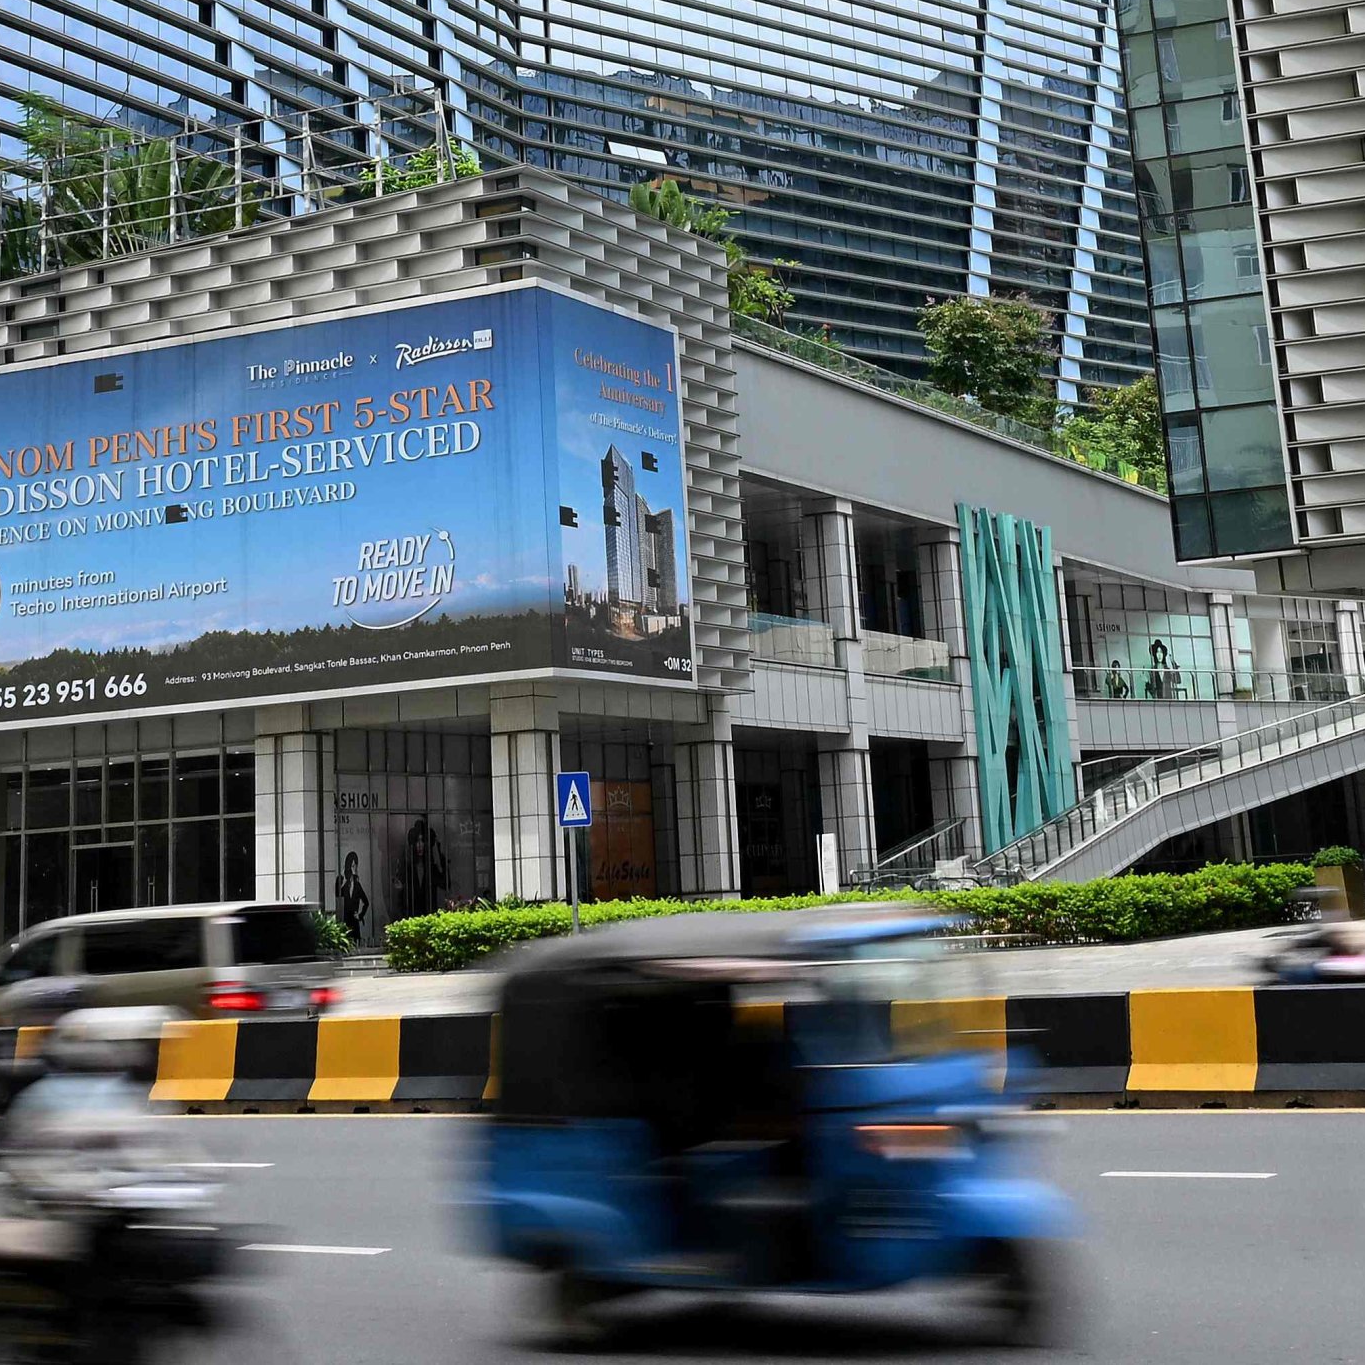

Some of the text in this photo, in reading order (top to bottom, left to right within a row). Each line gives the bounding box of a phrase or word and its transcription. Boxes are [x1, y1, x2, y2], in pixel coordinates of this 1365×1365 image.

[246, 364, 277, 381] The
[283, 352, 354, 376] Pinnacle
[395, 335, 473, 370] Radisson
[574, 347, 674, 393] Celebrating the 1
[261, 371, 338, 389] RESIDENCE
[599, 379, 667, 419] Anniversary
[88, 419, 218, 468] PENH'S
[231, 401, 341, 447] FIRST
[353, 379, 495, 428] 5-STAR
[590, 413, 677, 446] of The Pinnacle's Delivery!
[136, 421, 482, 499] HOTEL-SERVICED
[57, 516, 89, 537] ON
[93, 500, 215, 533] MONIVNG
[221, 481, 357, 517] BOULEVARD
[358, 534, 432, 572] READY
[10, 576, 73, 595] minutes
[77, 569, 115, 587] from
[10, 577, 228, 617] Techo International Airport
[332, 563, 455, 607] TO MOVE IN
[164, 641, 511, 686] Address: 93 Monivong Boulevard, Sangkat Tonle Bassac, Khan Chamkarmon, Phnom Penh
[571, 646, 604, 658] UNIT TYPES
[22, 683, 50, 706] 23
[56, 678, 95, 703] 951
[104, 673, 148, 697] 666
